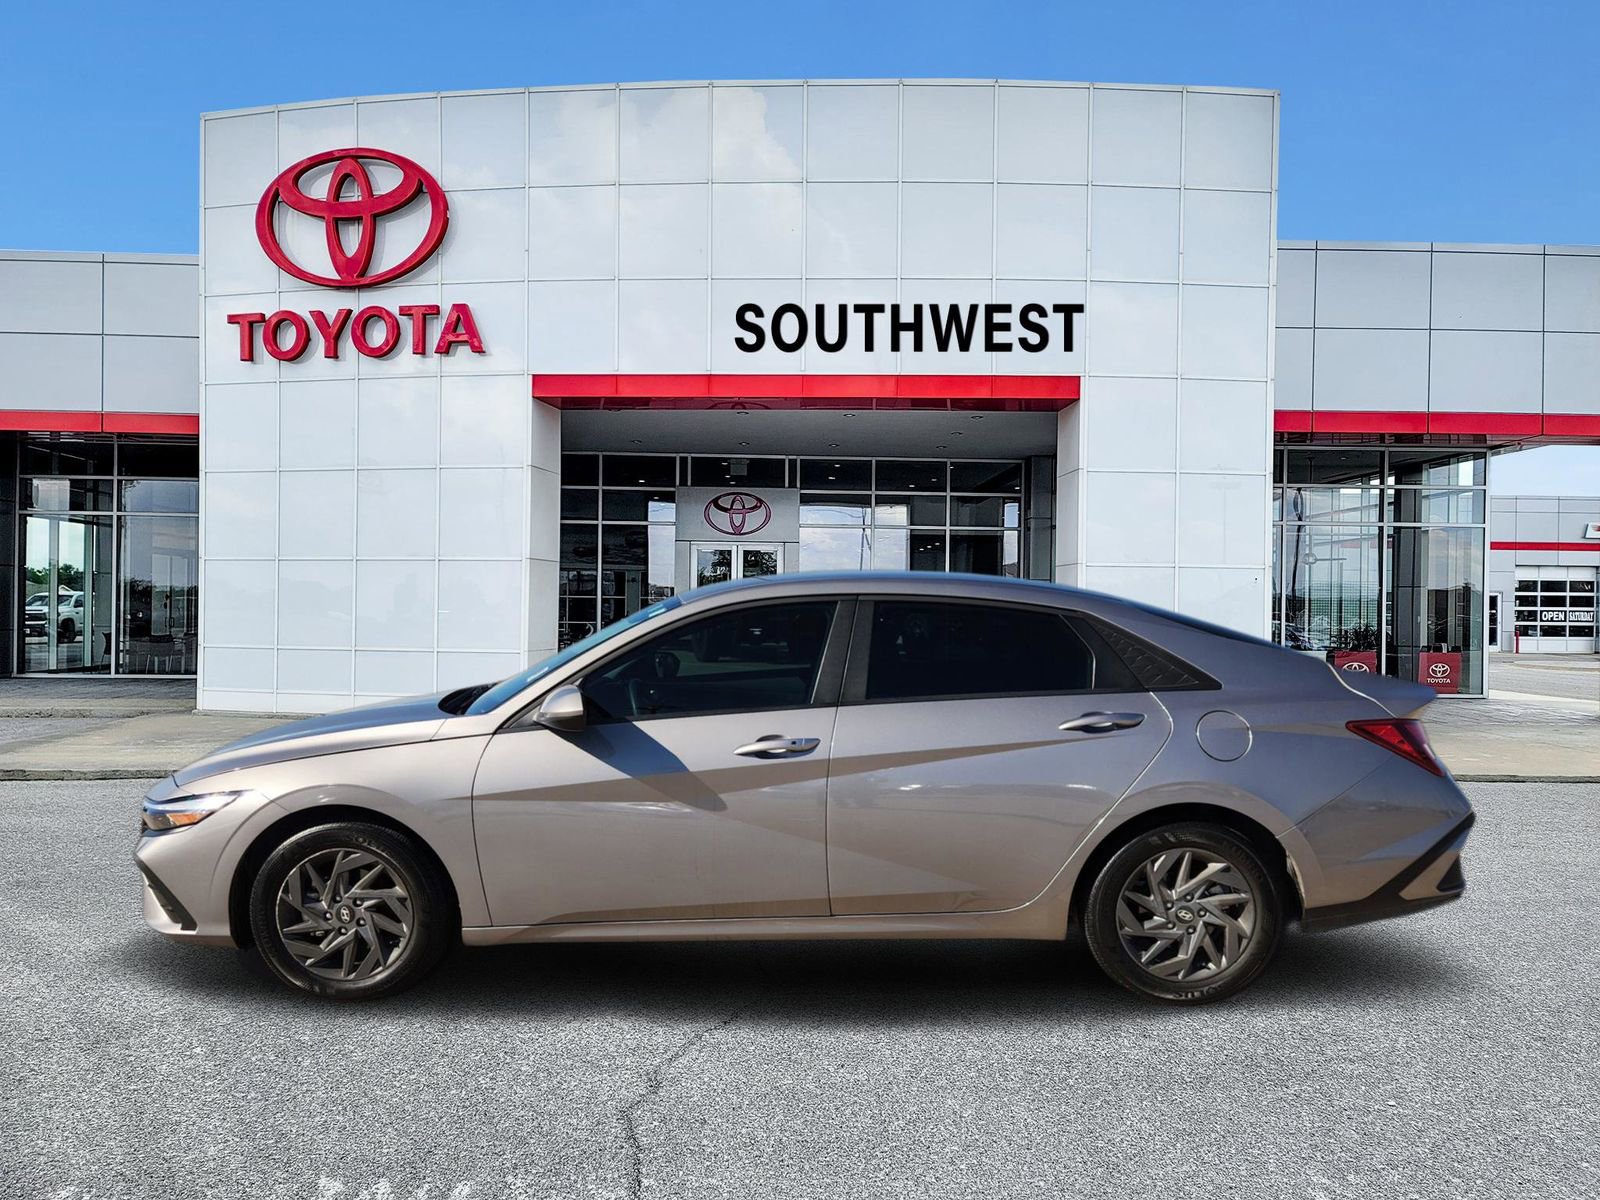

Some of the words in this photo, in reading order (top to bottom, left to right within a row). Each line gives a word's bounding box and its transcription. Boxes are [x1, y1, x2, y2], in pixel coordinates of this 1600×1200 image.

[227, 303, 486, 362] TOYOTA
[734, 303, 1085, 353] SOUTHWEST
[1541, 611, 1565, 621] OPEN
